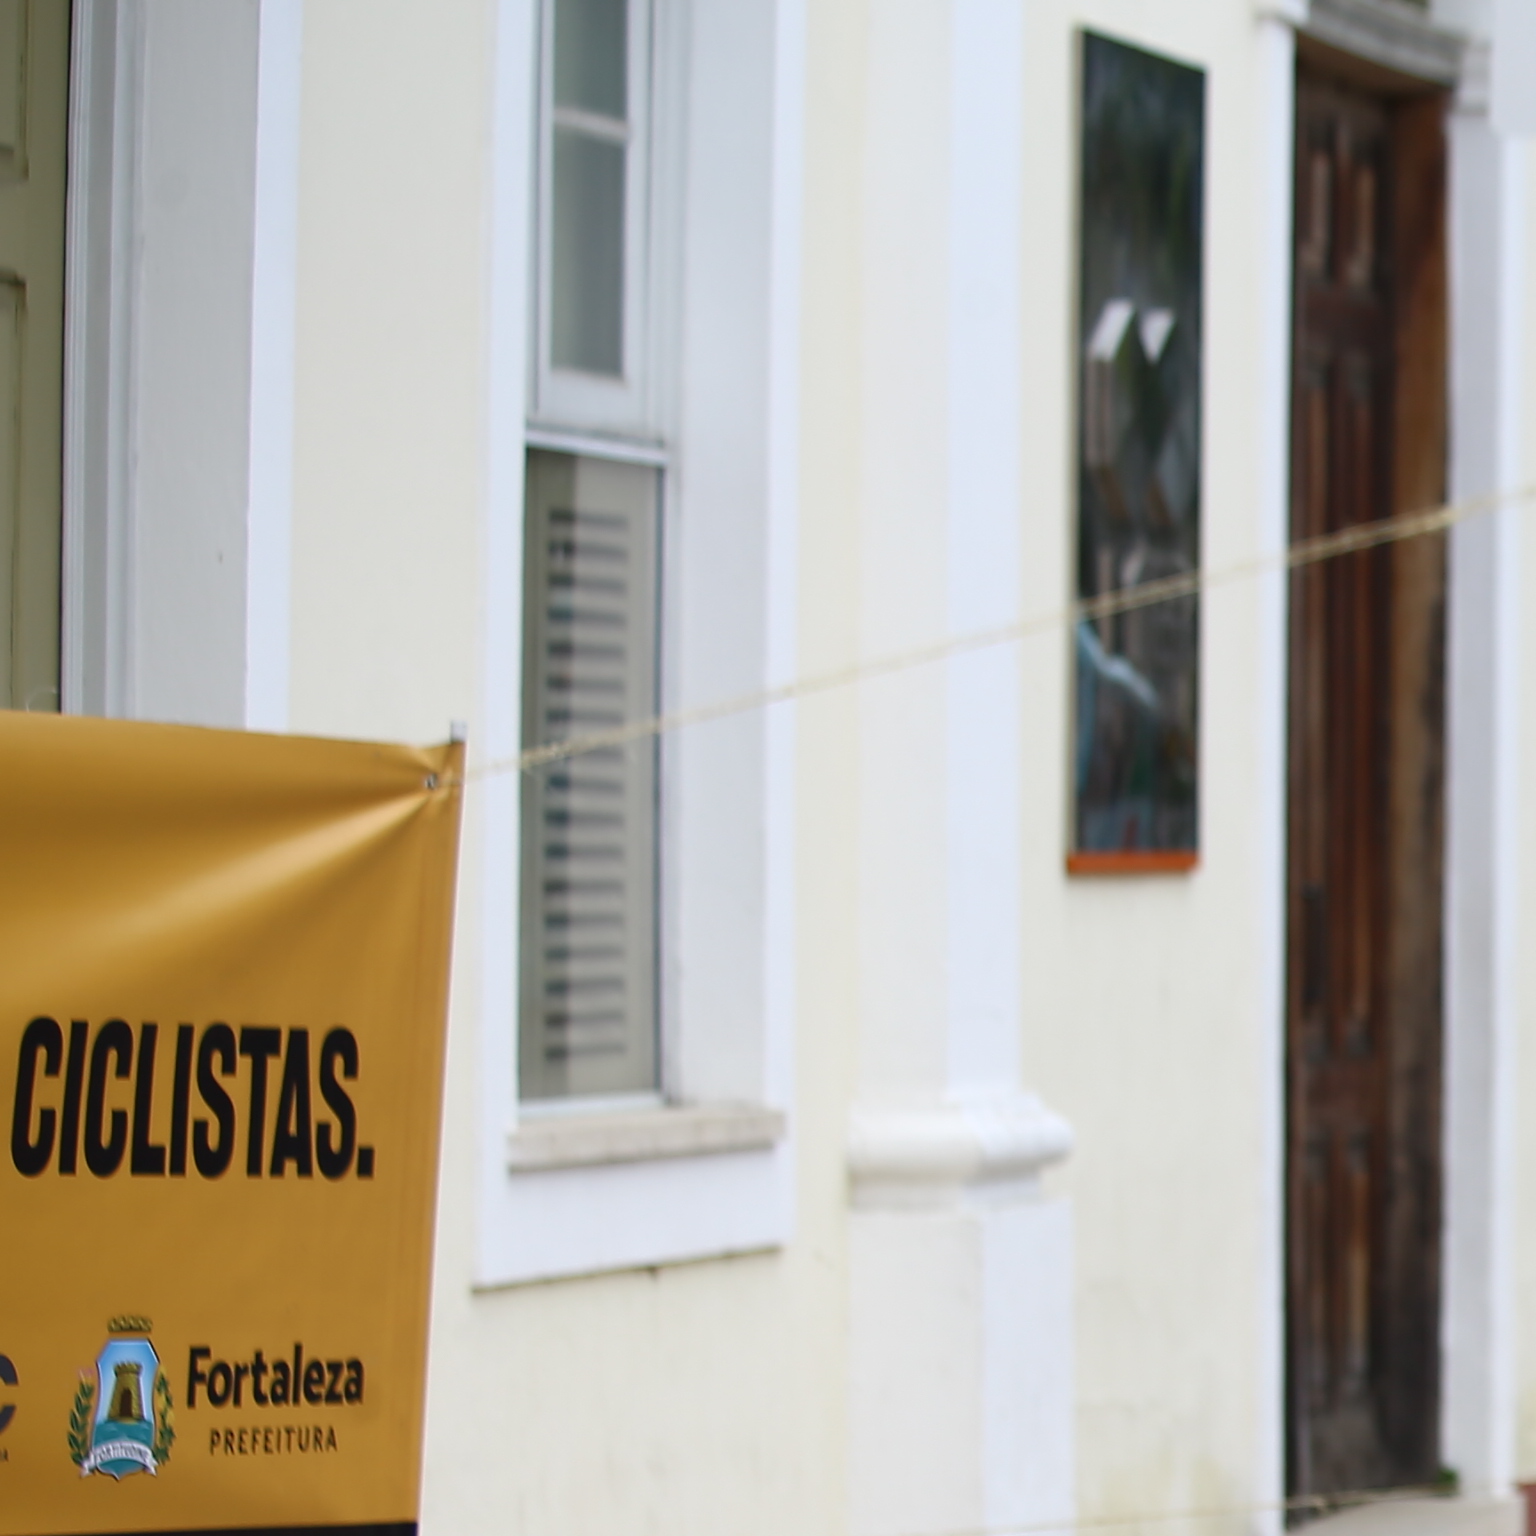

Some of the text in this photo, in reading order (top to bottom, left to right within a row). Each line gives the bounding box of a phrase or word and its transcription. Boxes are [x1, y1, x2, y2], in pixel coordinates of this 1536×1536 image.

[11, 1015, 376, 1181] CICLISTAS.
[186, 1343, 365, 1411] Fortaleza
[210, 1424, 338, 1456] PREFEITURA
